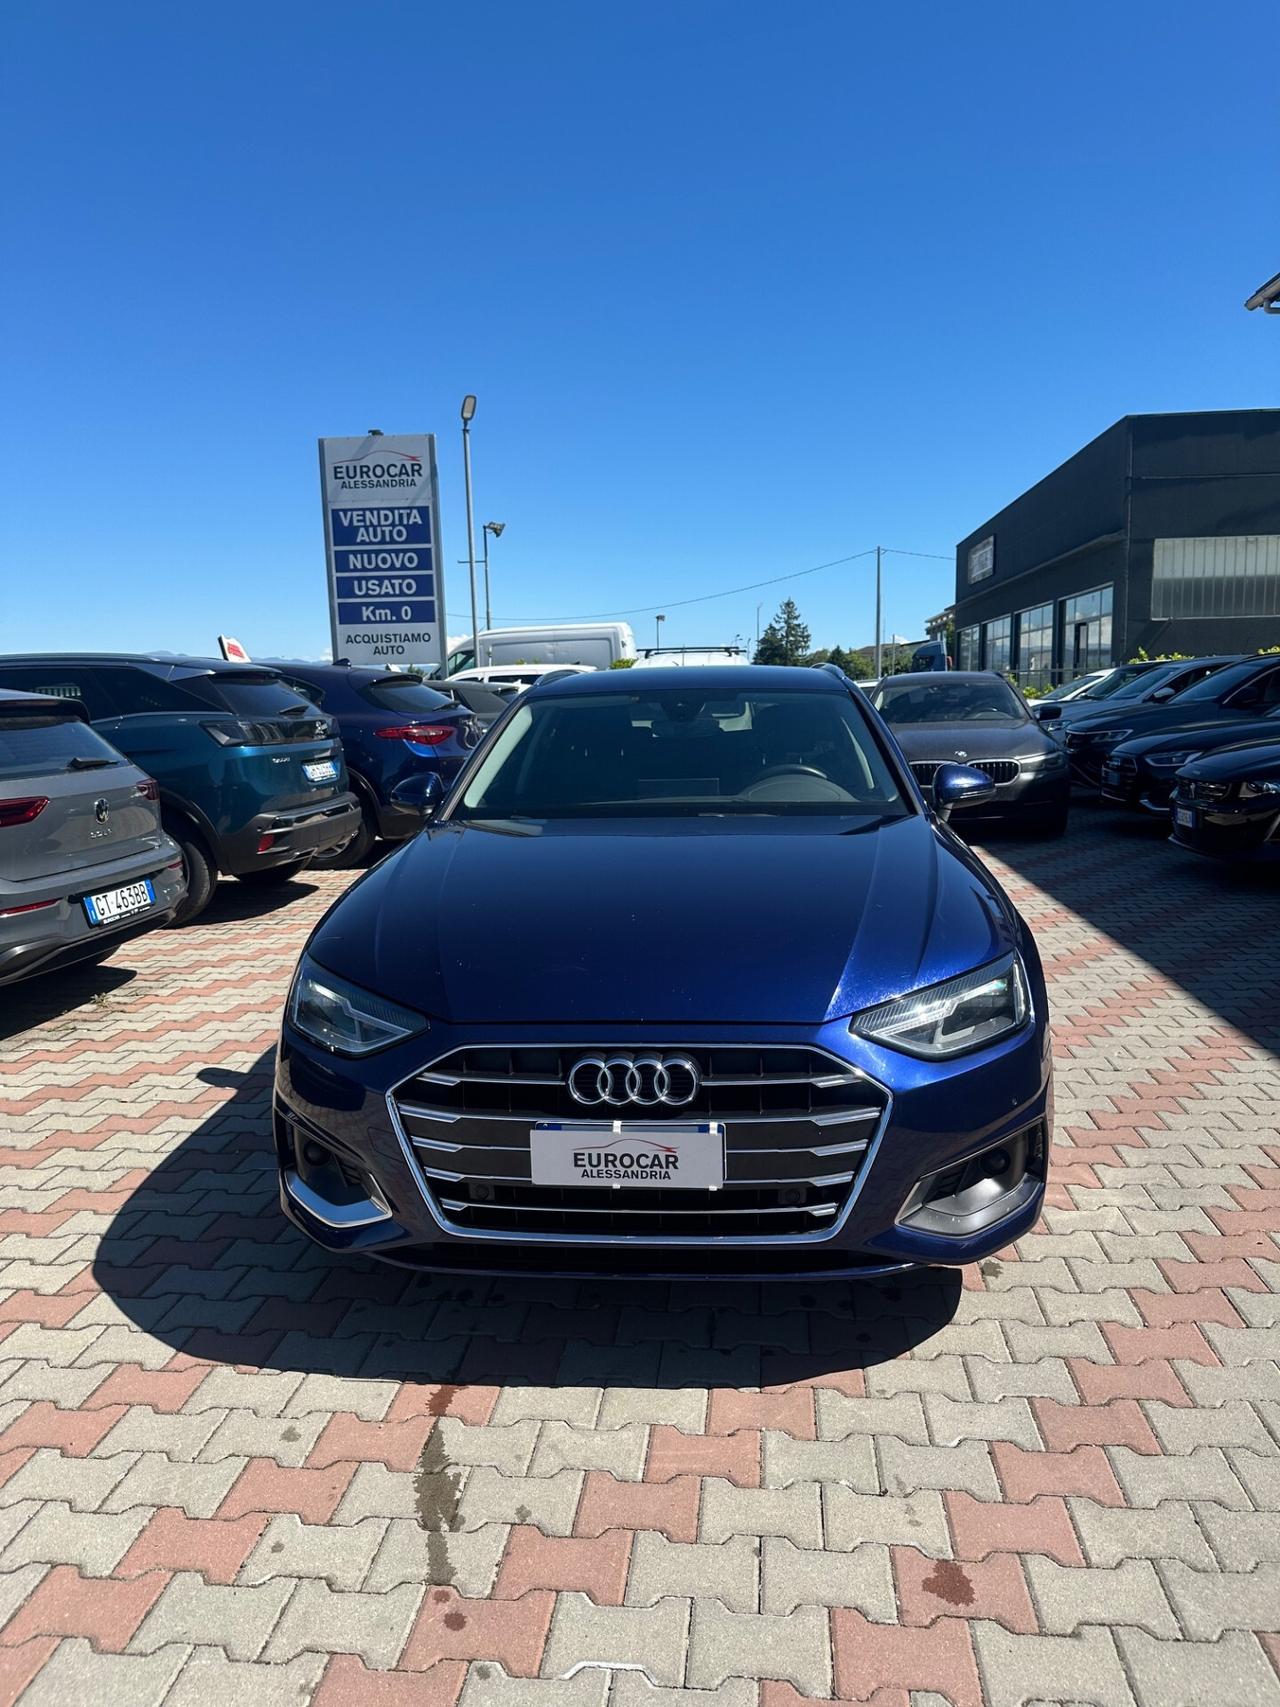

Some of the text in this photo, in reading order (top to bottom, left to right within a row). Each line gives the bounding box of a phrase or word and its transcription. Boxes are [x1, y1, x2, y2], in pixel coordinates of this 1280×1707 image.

[333, 463, 423, 480] EUROCAR
[341, 479, 417, 489] ALESSANDRIA
[339, 509, 422, 527] VENDITA
[356, 526, 407, 543] AUTO
[349, 552, 418, 570] NUOVO
[353, 579, 417, 596] USATO
[361, 605, 412, 621] Km. 0
[345, 632, 431, 645] ACQUISTIAMO
[373, 645, 405, 656] AUTO
[573, 1152, 679, 1170] EUROCAR
[581, 1168, 671, 1180] ALESSANDRIA
